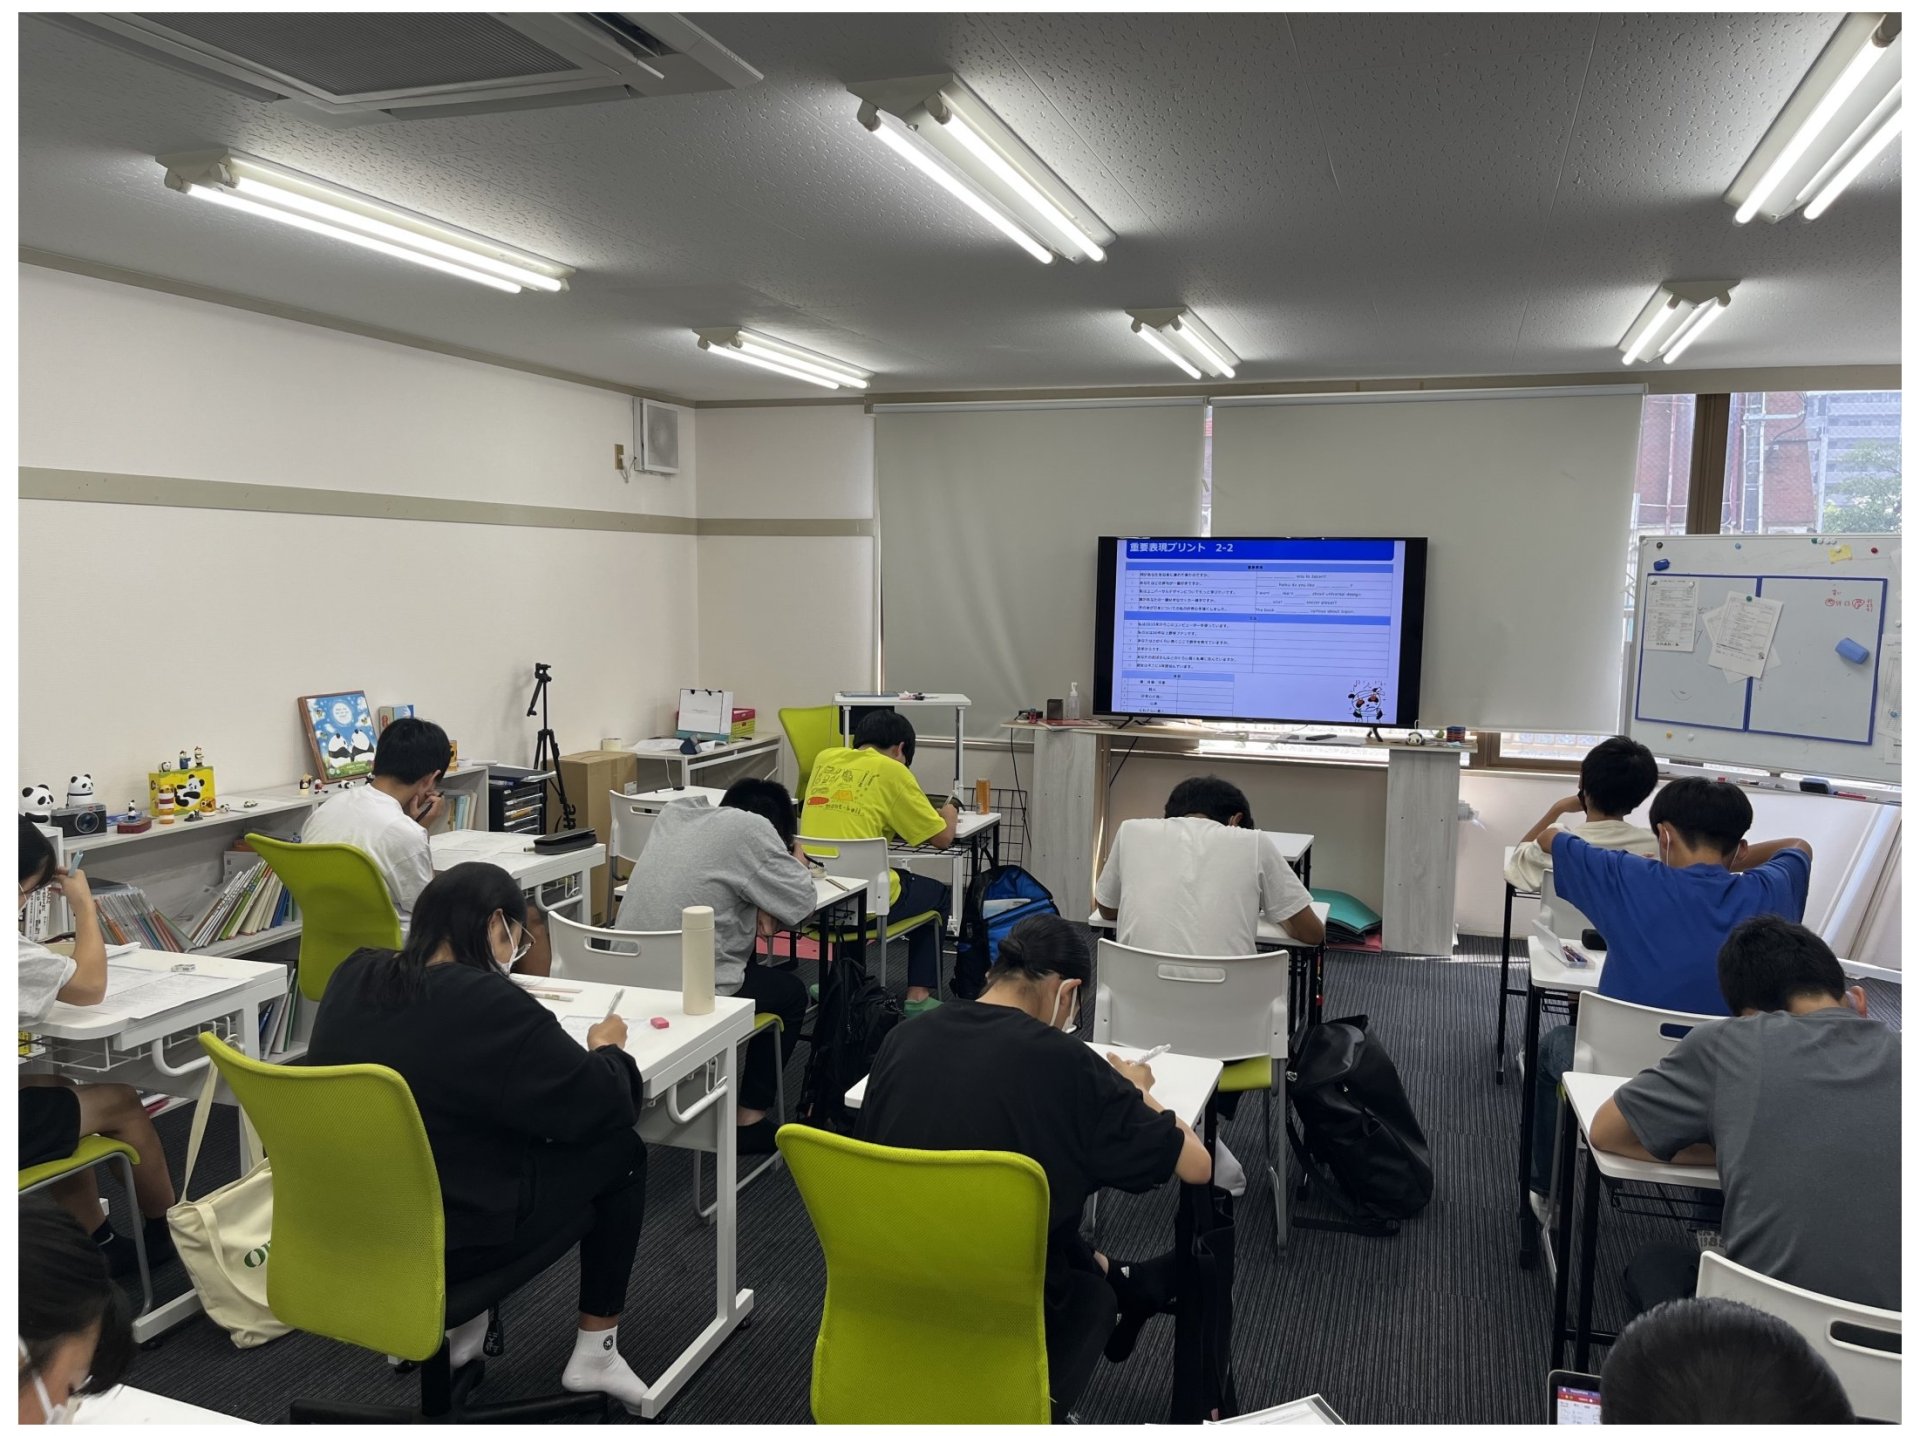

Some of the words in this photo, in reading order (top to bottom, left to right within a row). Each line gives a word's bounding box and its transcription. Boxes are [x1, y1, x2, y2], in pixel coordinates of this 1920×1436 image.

[1129, 542, 1206, 553] 重要表現プリント
[1215, 543, 1234, 552] 2-2
